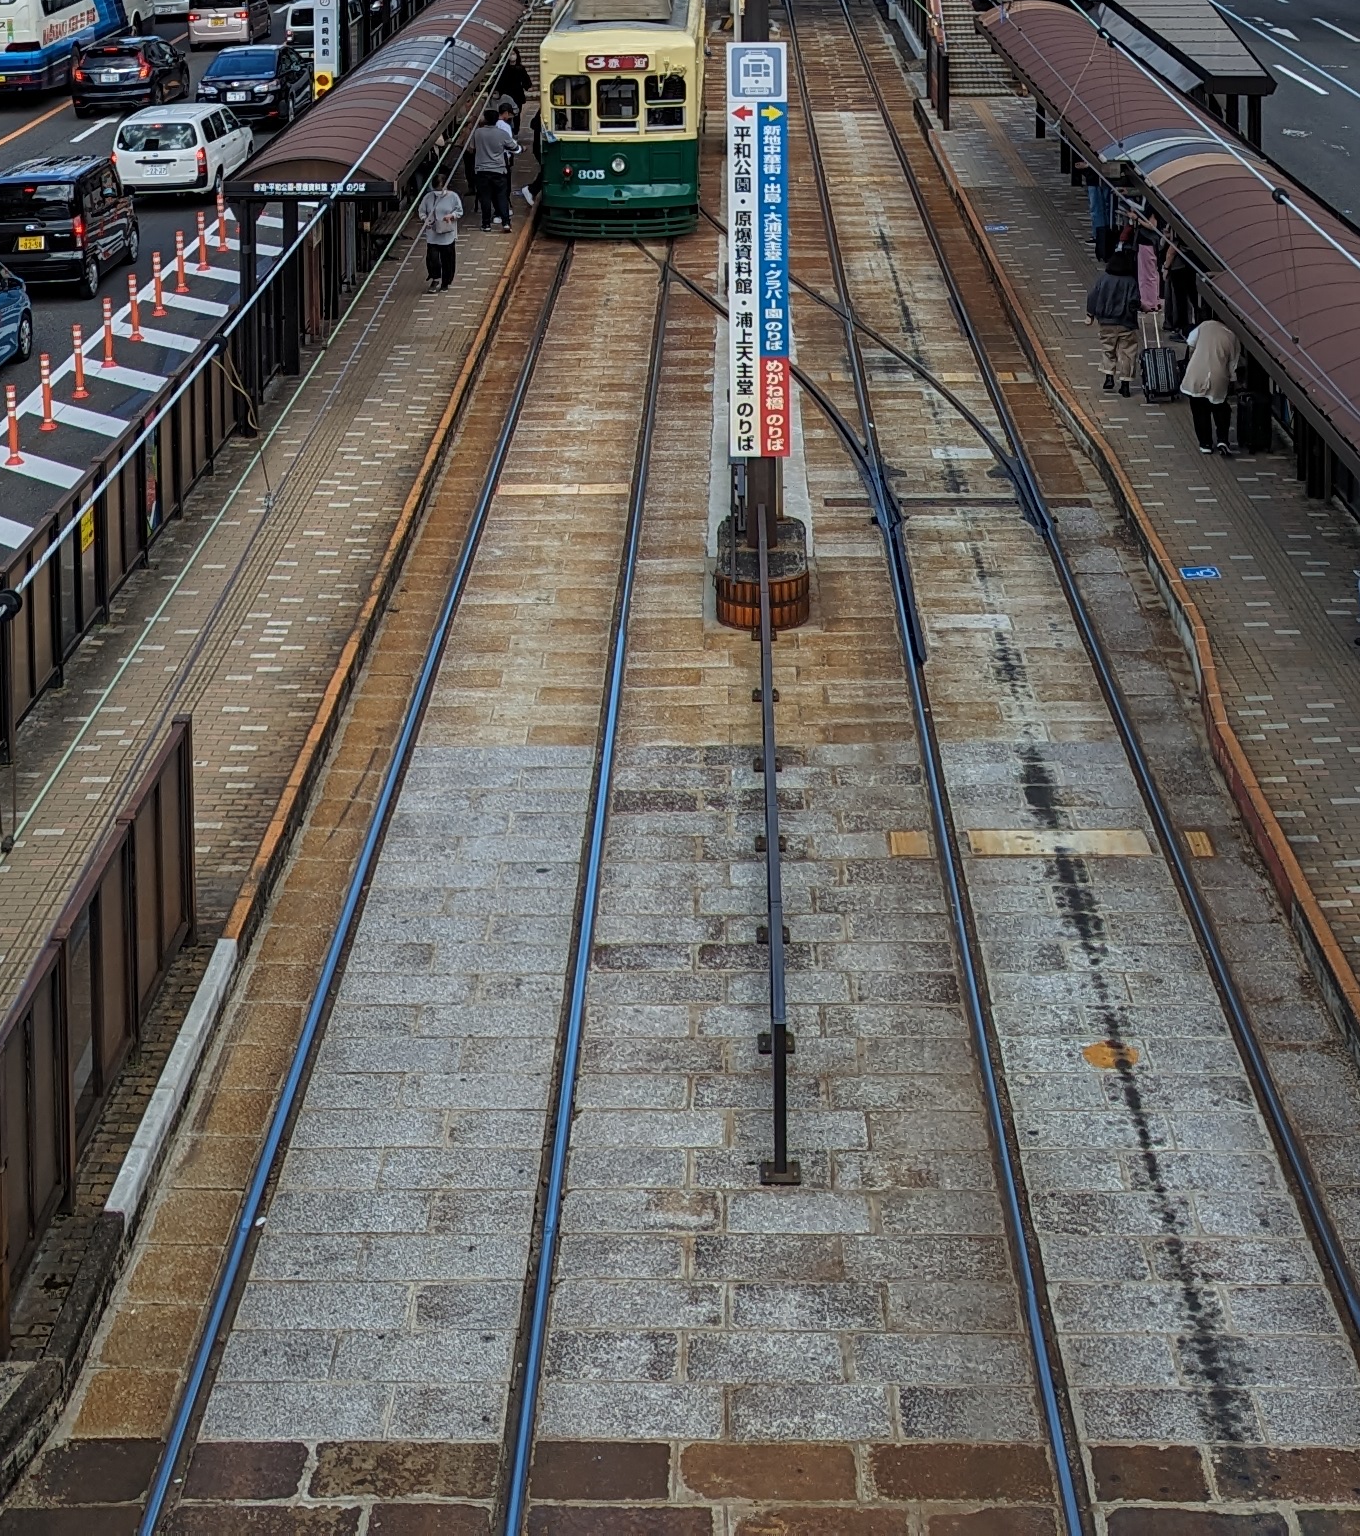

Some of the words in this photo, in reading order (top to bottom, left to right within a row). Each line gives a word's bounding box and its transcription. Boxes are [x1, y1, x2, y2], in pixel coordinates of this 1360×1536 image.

[586, 56, 606, 69] 3
[733, 126, 754, 396] 平和公園・原爆資料館・浦上天主堂
[764, 321, 783, 351] のりば
[765, 360, 784, 411] めがね橋
[736, 402, 754, 452] のりば
[766, 414, 784, 451] のりば
